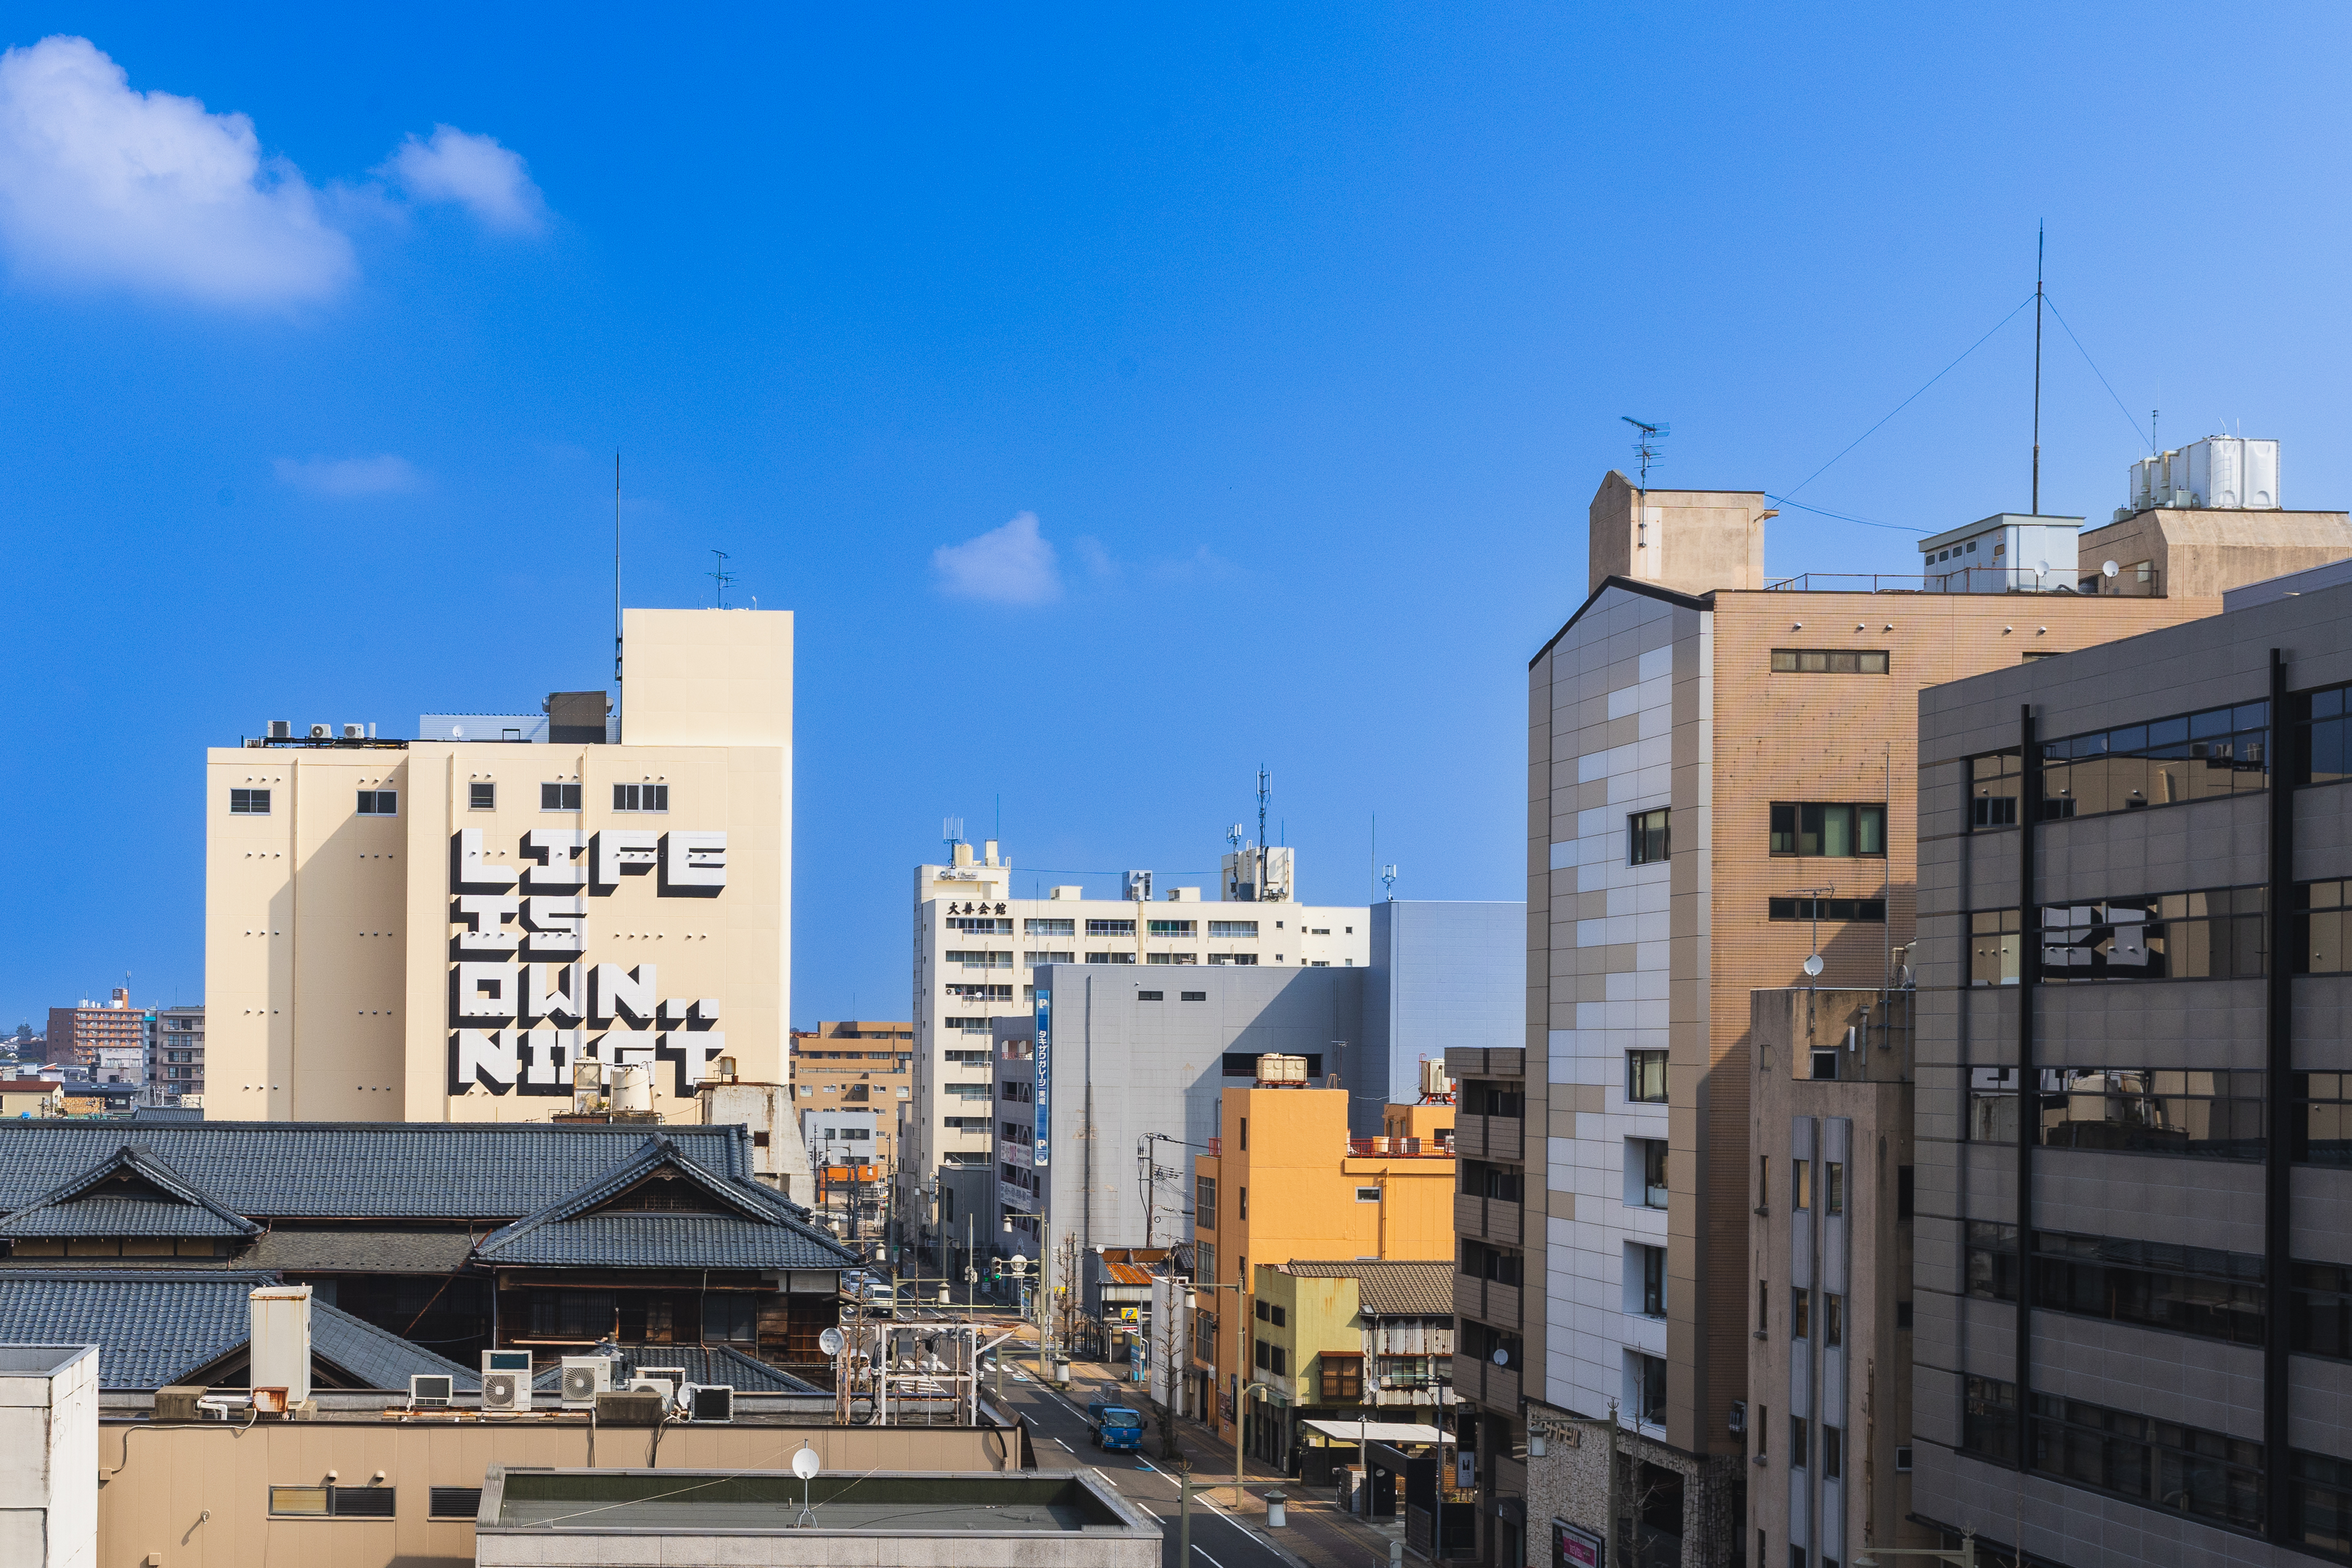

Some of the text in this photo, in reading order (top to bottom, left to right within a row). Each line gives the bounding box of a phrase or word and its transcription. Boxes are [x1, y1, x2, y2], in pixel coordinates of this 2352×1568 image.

[450, 828, 727, 898] LIFE
[449, 895, 587, 963] IS
[1038, 998, 1048, 1009] P
[1038, 1030, 1047, 1105] タキザワガレージ 東堀
[1037, 1139, 1046, 1150] P
